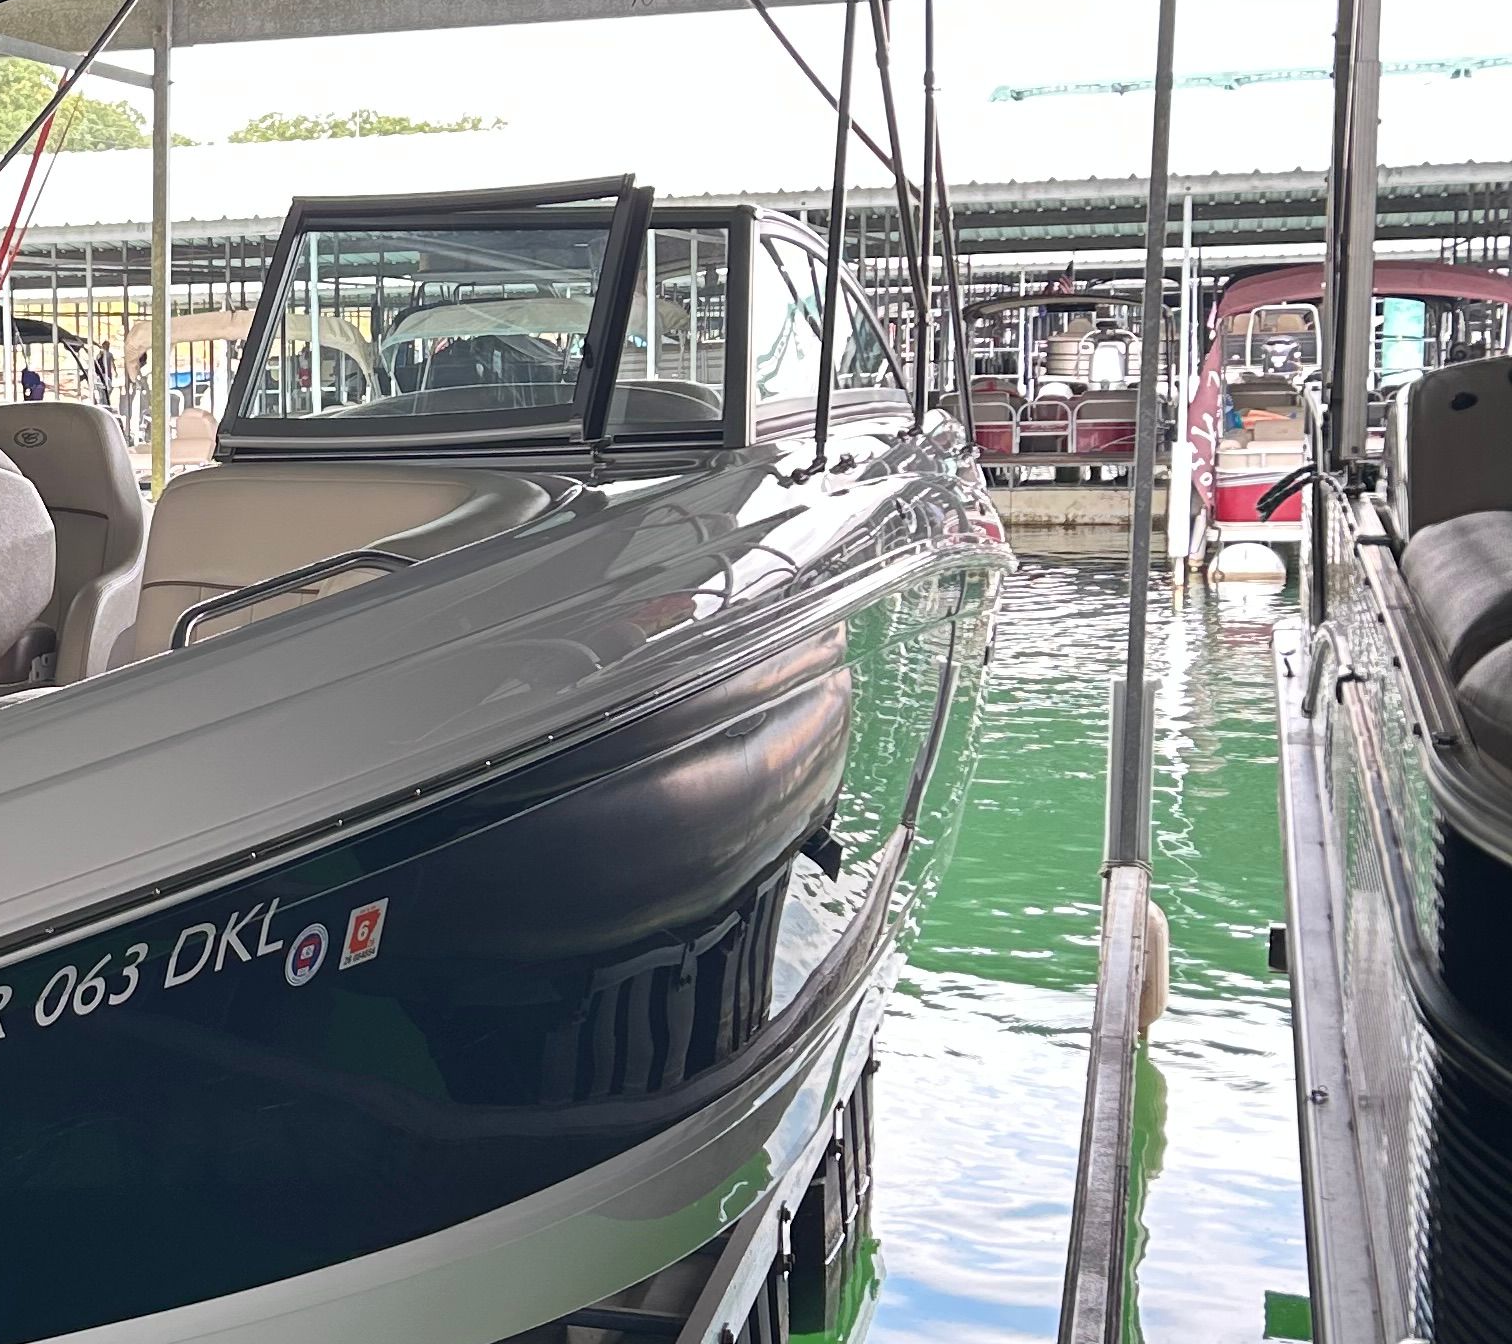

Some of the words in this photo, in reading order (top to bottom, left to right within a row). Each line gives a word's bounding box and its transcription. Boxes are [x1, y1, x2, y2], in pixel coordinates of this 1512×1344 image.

[34, 942, 149, 1028] 063
[164, 897, 284, 989] DKL
[357, 920, 370, 942] 6
